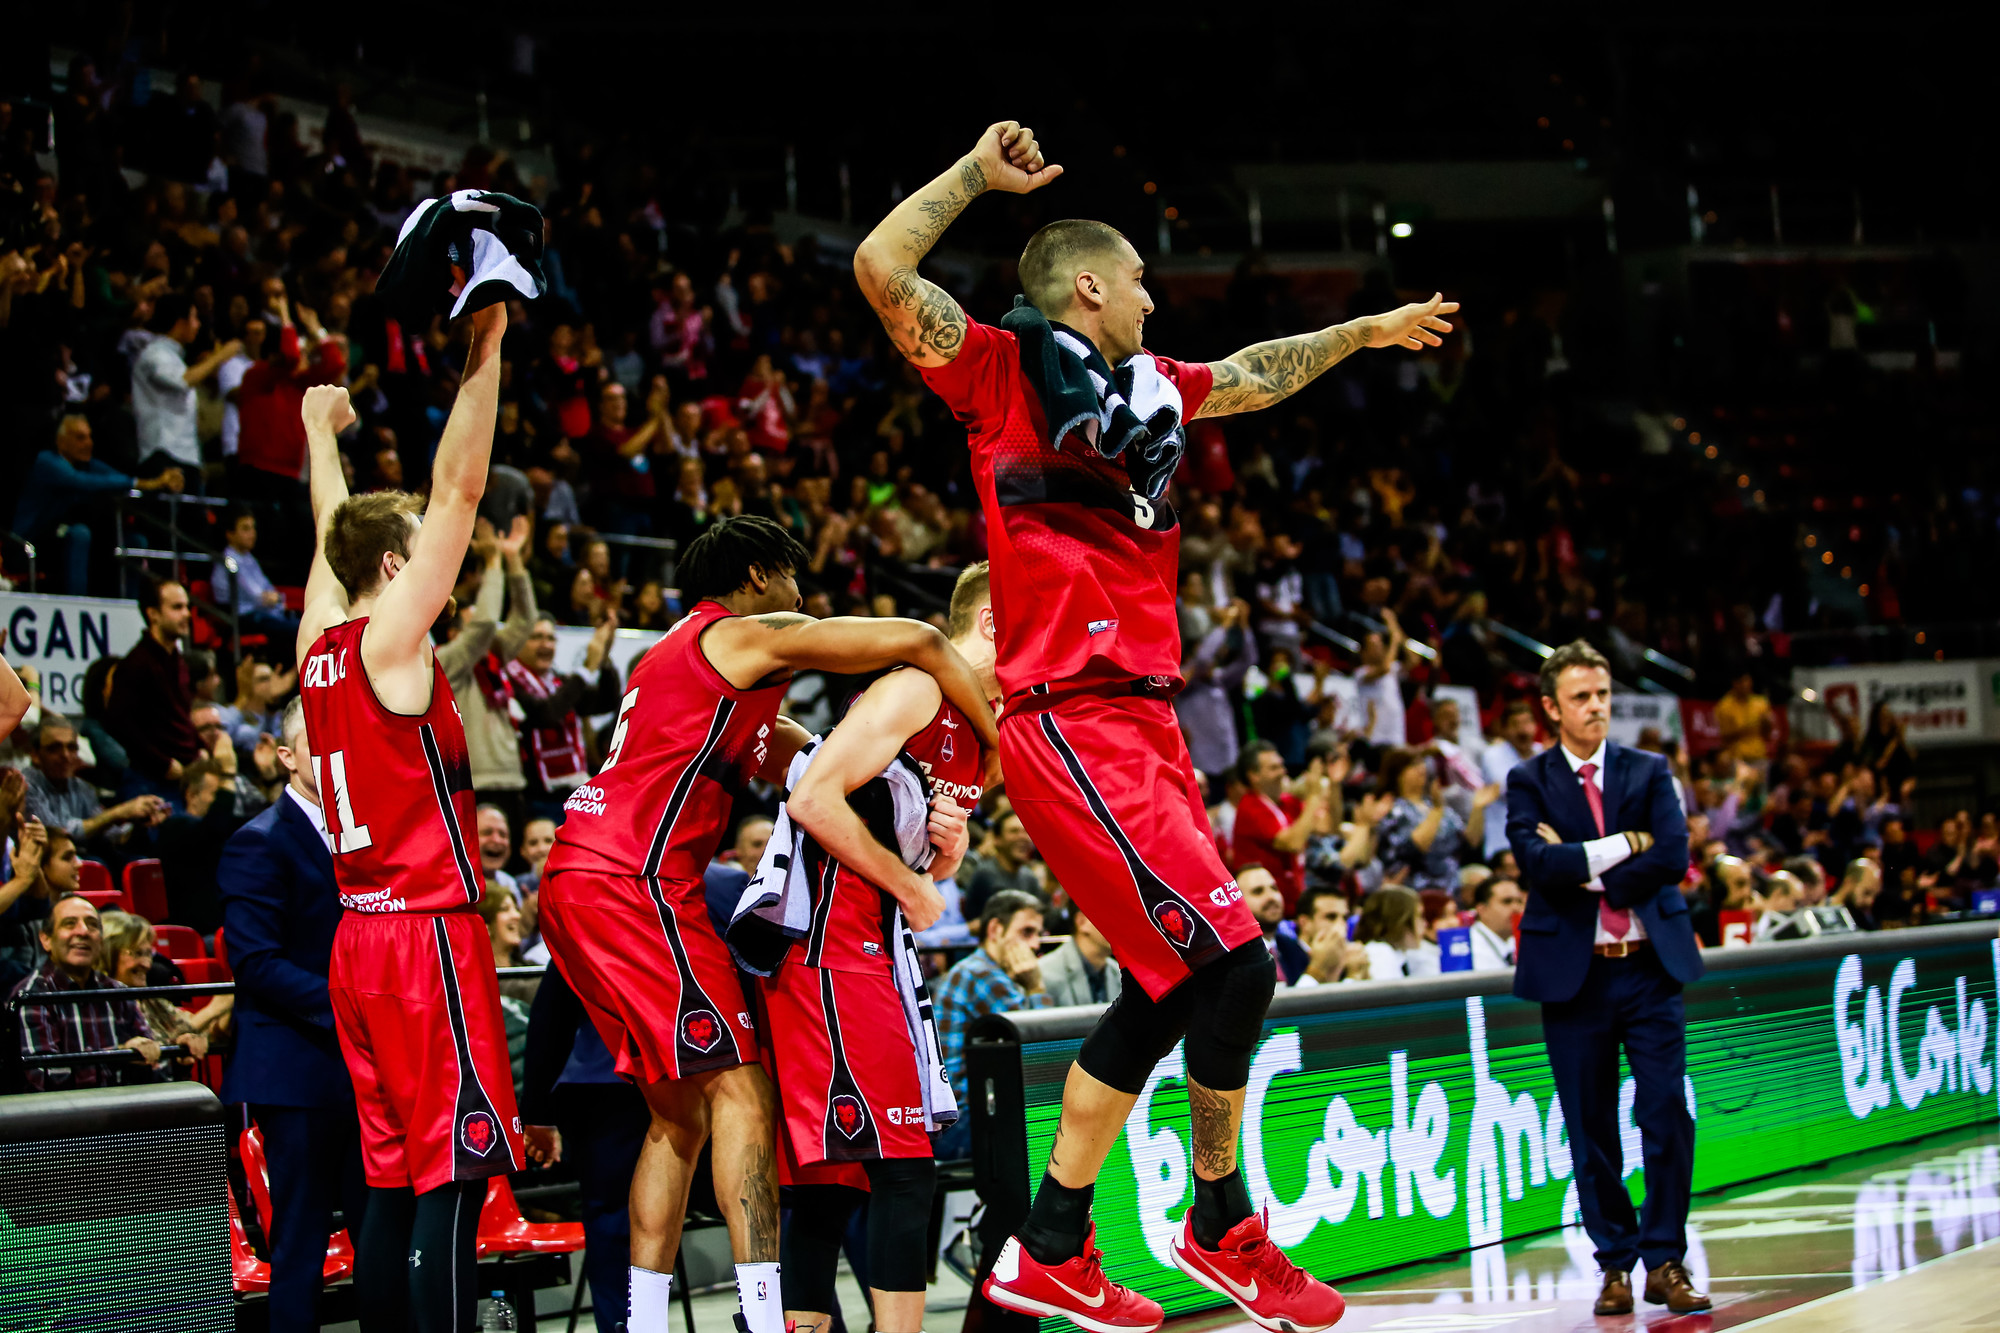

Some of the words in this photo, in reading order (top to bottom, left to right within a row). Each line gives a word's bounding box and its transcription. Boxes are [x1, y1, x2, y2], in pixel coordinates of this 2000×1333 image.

[0, 605, 110, 660] GAN
[1887, 957, 1993, 1111] Corte
[1242, 1027, 1457, 1248] Corte
